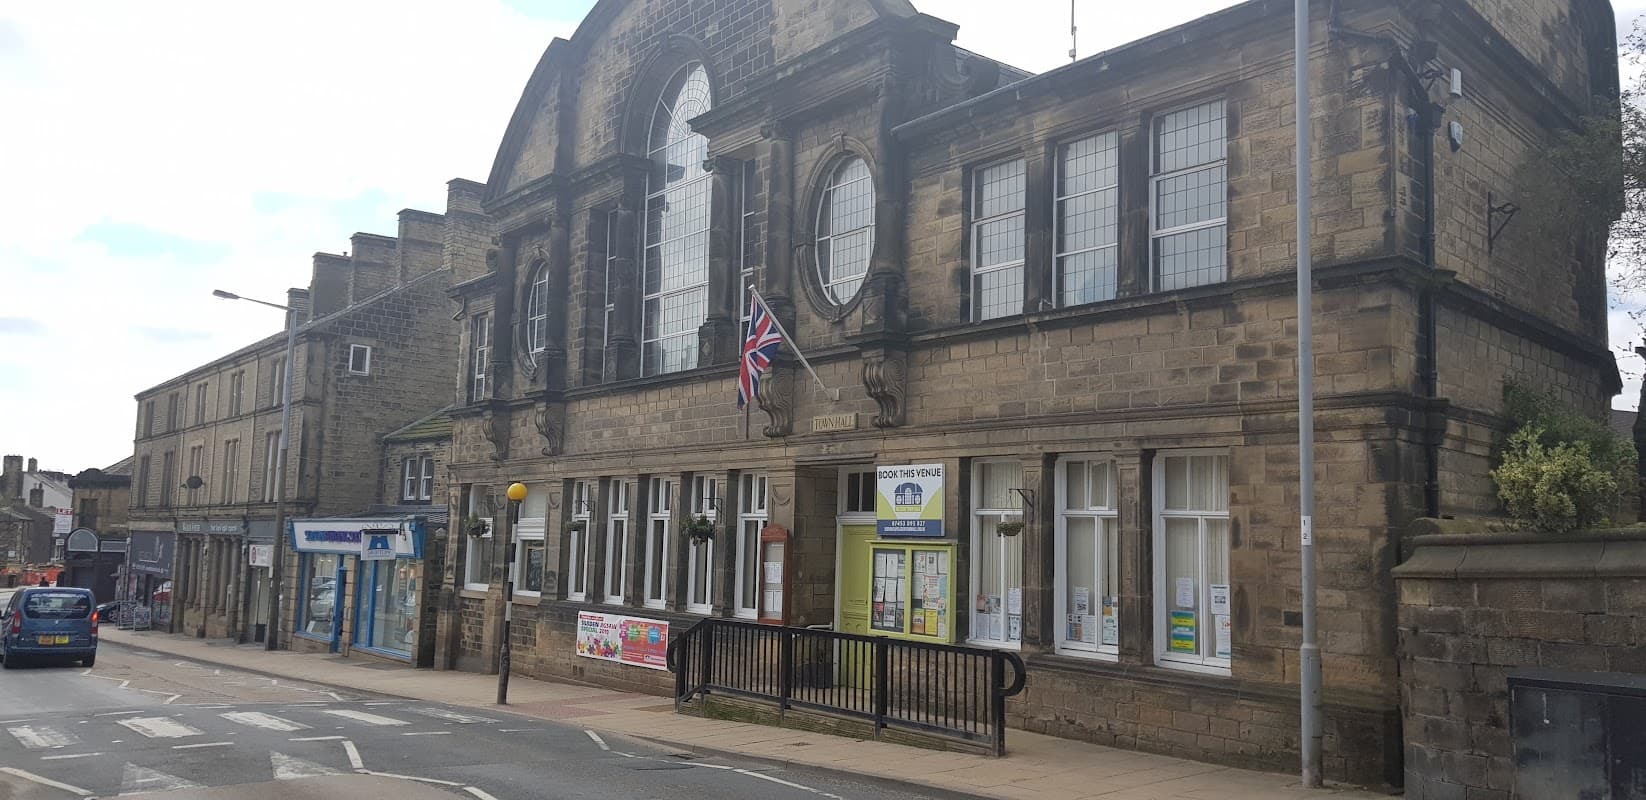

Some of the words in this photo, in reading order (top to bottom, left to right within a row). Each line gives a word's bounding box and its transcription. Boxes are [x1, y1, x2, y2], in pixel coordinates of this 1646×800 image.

[815, 417, 834, 430] TOWN
[835, 415, 852, 428] HALL
[878, 470, 898, 480] BOOK
[899, 469, 915, 478] THIS
[916, 467, 942, 477] VENUE
